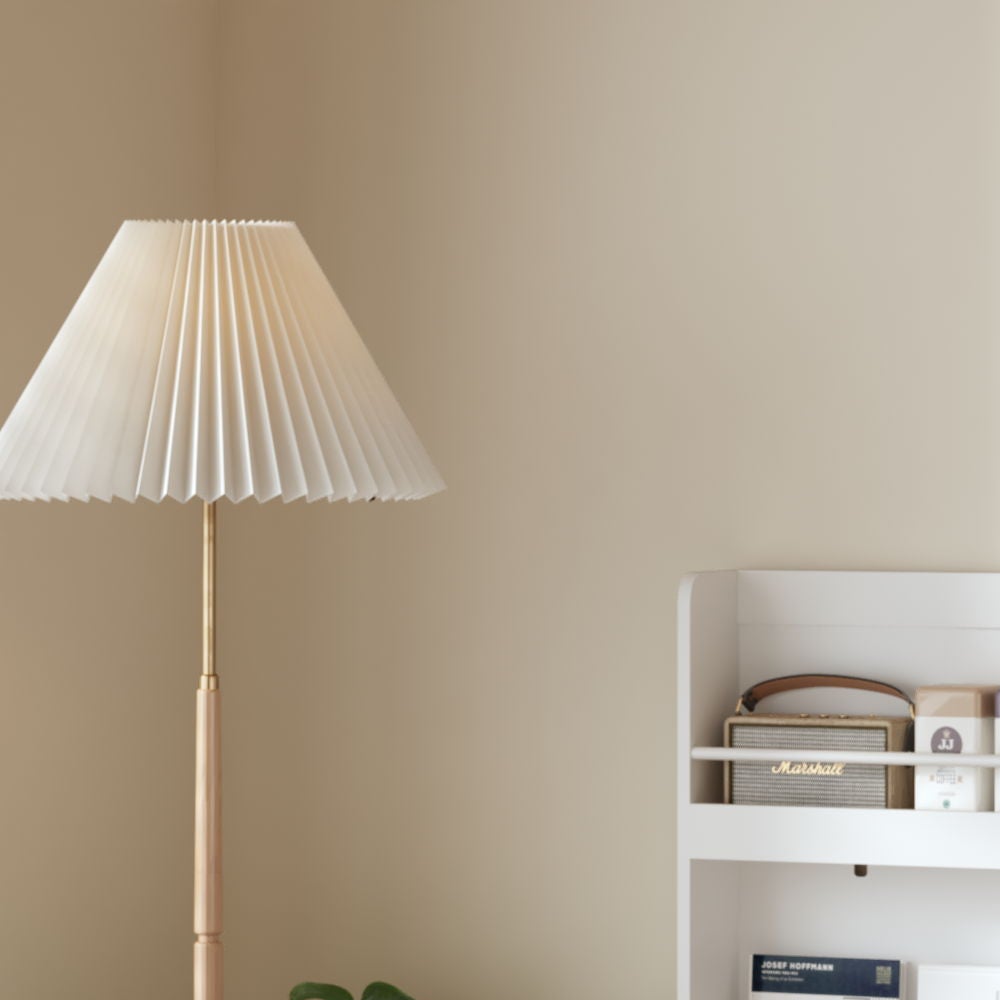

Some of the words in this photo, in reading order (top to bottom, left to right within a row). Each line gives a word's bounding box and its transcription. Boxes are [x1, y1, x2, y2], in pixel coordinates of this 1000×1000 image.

[937, 738, 954, 751] JJ
[771, 760, 846, 775] Marshall
[761, 961, 787, 970] JOSEF
[789, 962, 834, 972] HOFFMANN
